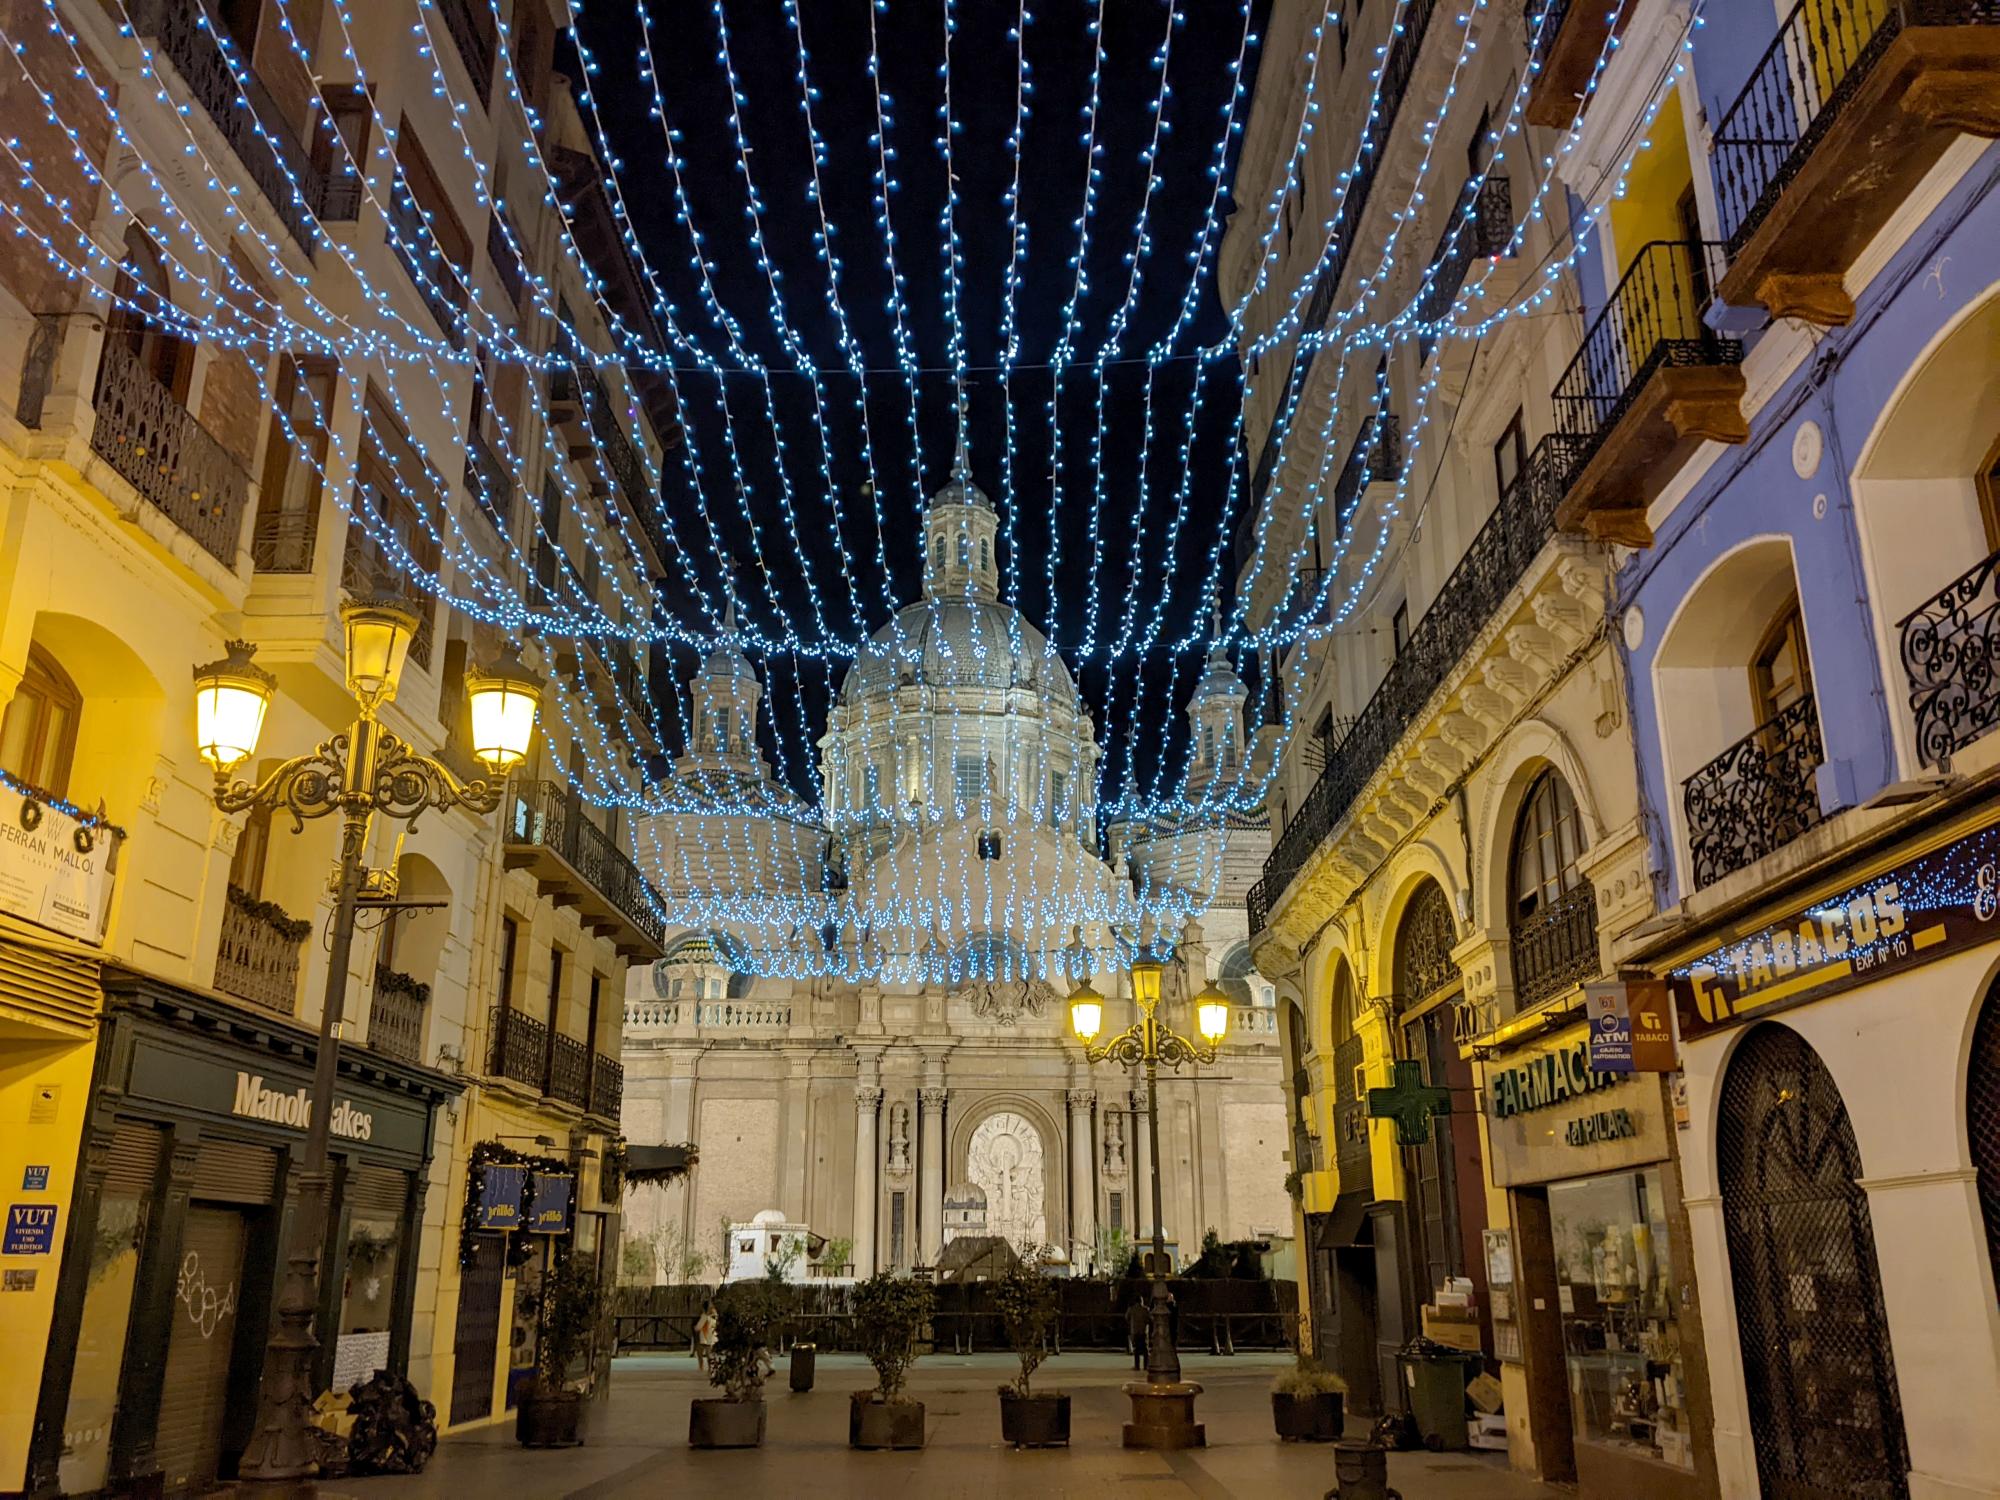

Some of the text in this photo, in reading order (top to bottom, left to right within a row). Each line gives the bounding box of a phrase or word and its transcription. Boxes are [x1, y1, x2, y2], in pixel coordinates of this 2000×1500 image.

[0, 822, 46, 856] FERRAN
[53, 845, 95, 875] MALLOL
[1730, 882, 1906, 992] TABACOS
[1855, 952, 1876, 972] EXP.
[1892, 940, 1907, 958] 10
[1592, 1031, 1629, 1044] ATM
[1635, 1033, 1670, 1042] TABACO
[329, 1098, 372, 1141] akes
[1583, 1108, 1633, 1143] PILAR
[27, 1167, 48, 1177] VUT
[13, 1208, 53, 1226] VUT
